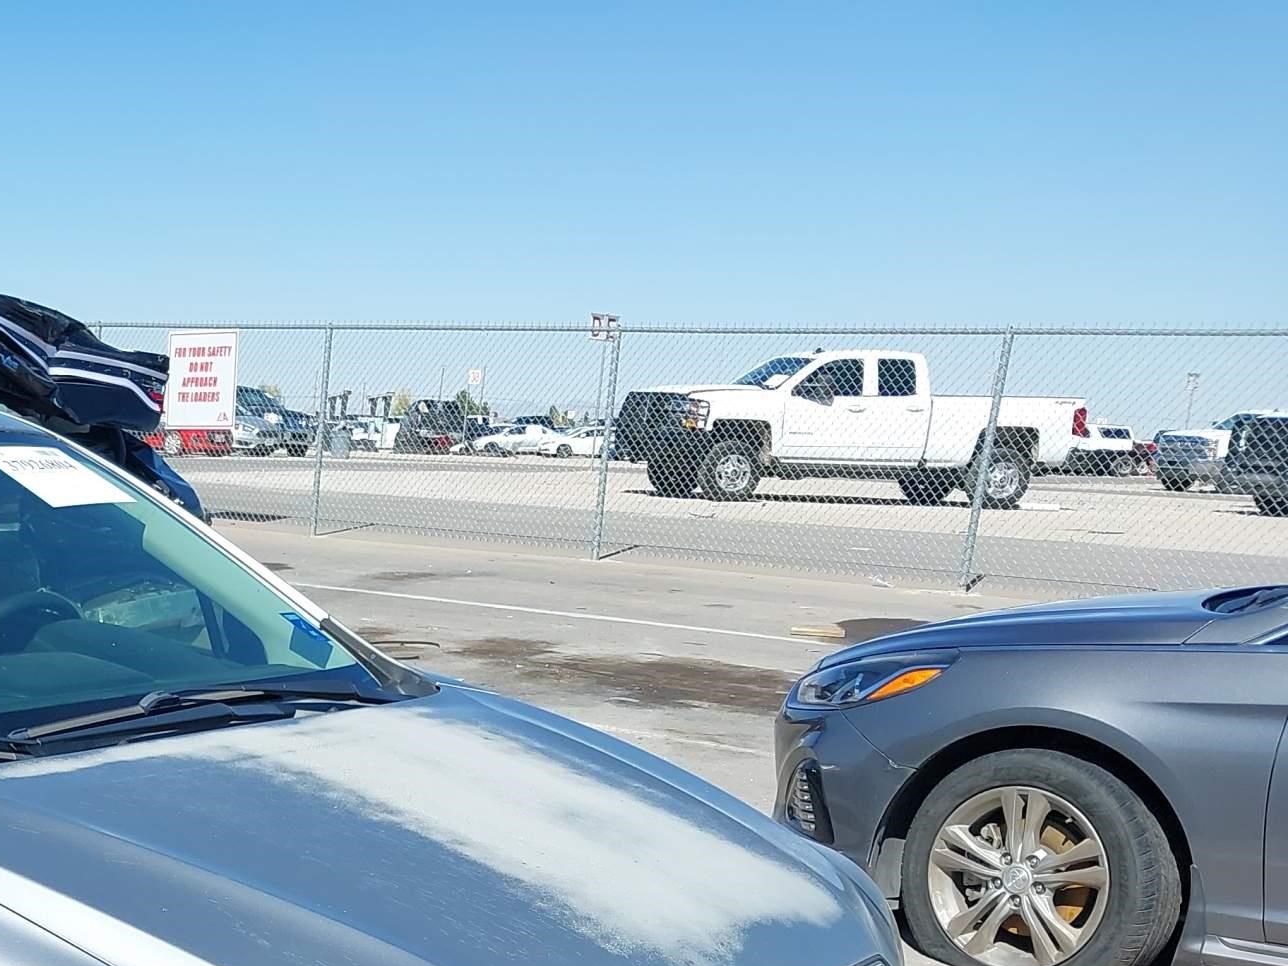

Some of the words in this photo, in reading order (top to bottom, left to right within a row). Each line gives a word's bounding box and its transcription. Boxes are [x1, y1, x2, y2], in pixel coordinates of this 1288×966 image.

[174, 347, 187, 358] FOR
[188, 347, 206, 358] YOUR
[207, 346, 232, 357] SAFETY
[189, 361, 198, 372] DO
[199, 361, 213, 372] NOT
[182, 376, 218, 387] APPROACH
[178, 392, 190, 402] THE
[190, 392, 220, 402] LOADERS
